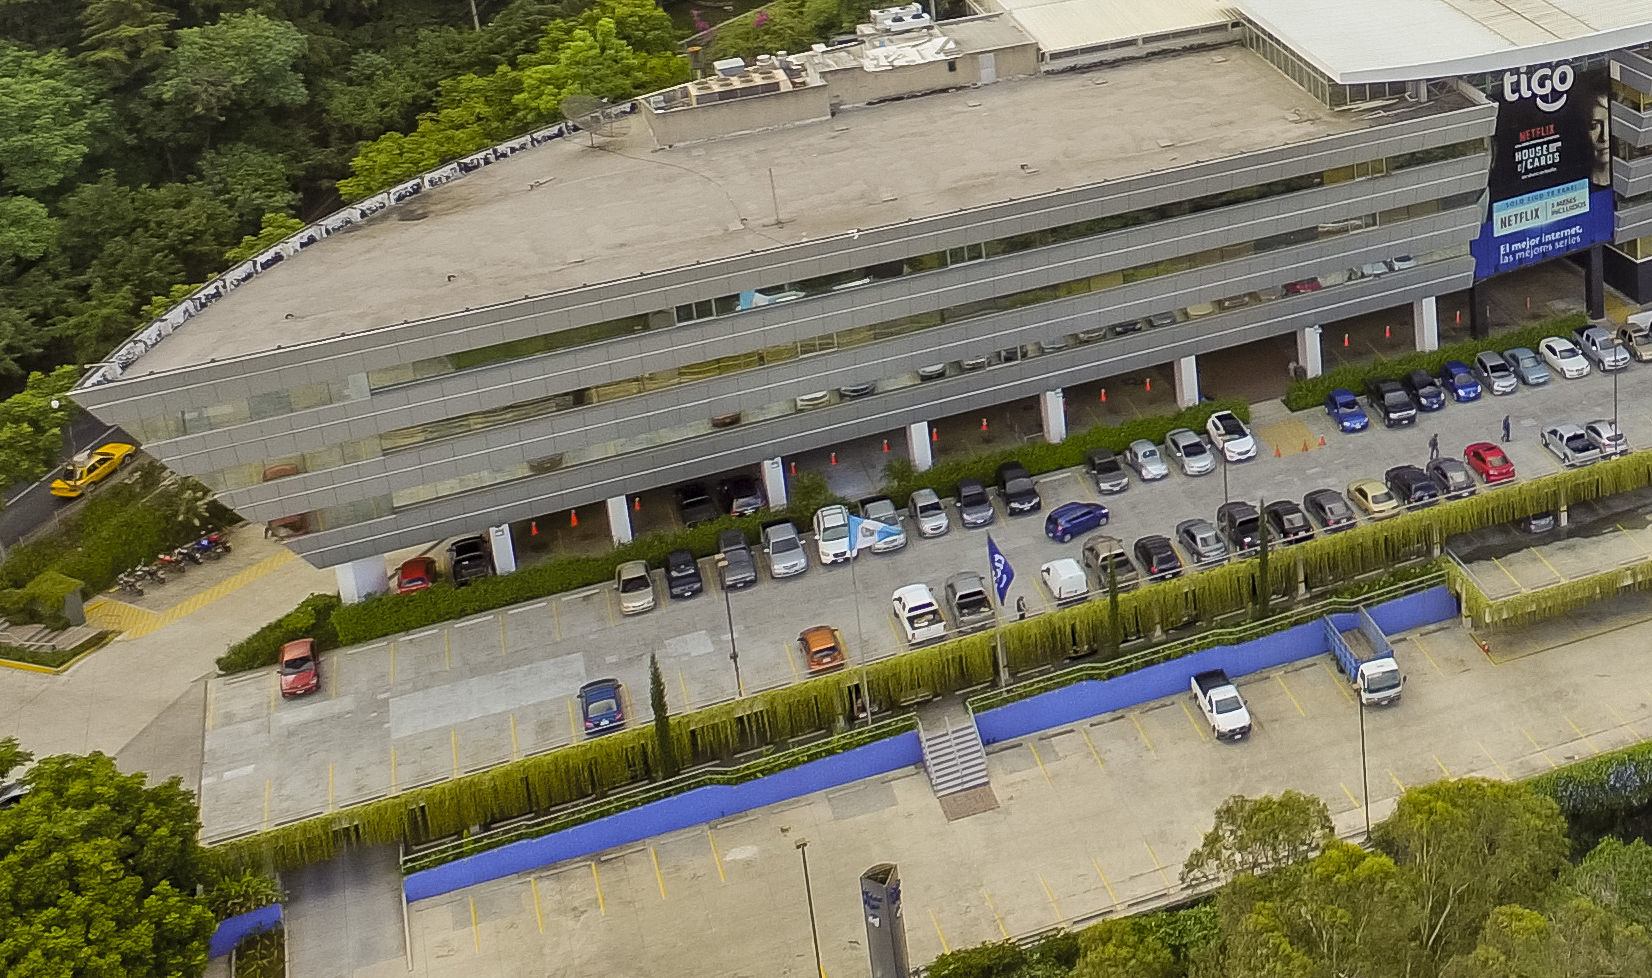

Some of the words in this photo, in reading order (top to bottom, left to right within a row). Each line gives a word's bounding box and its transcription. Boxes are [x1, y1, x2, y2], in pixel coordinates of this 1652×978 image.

[1503, 65, 1574, 111] tigo
[1519, 124, 1554, 141] NETFLIX
[1515, 144, 1549, 161] HOUSE
[1527, 152, 1560, 169] CARDS
[1500, 207, 1540, 230] NETFLIX
[1511, 236, 1540, 251] mejor
